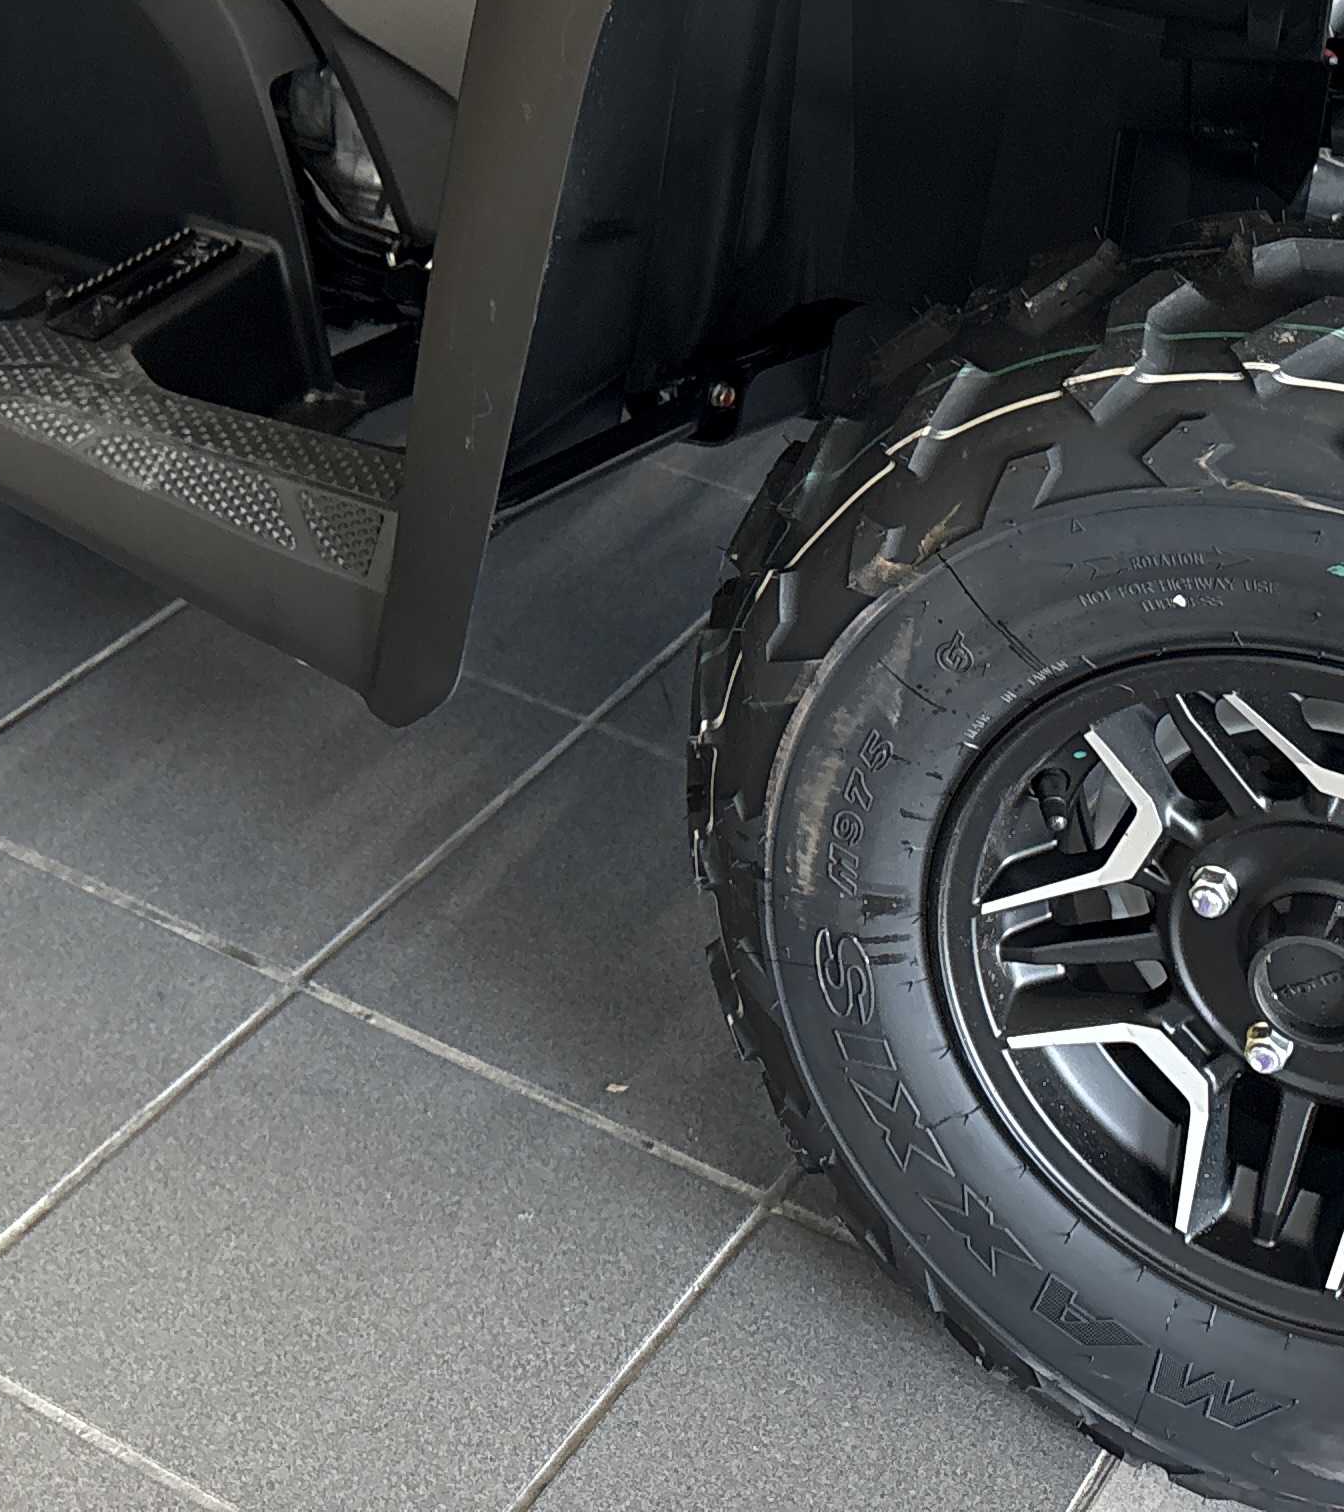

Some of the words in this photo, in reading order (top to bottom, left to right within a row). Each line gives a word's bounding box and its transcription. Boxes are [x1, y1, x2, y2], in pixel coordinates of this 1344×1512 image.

[1130, 553, 1205, 571] ROTATION
[1077, 587, 1113, 608] NOT
[1116, 580, 1156, 598] FOR
[1158, 576, 1236, 595] HIGHWAY
[1243, 579, 1279, 595] USE
[1027, 660, 1069, 688] TAIWAN
[827, 728, 894, 897] M975
[815, 926, 1294, 1430] MAXXIS
